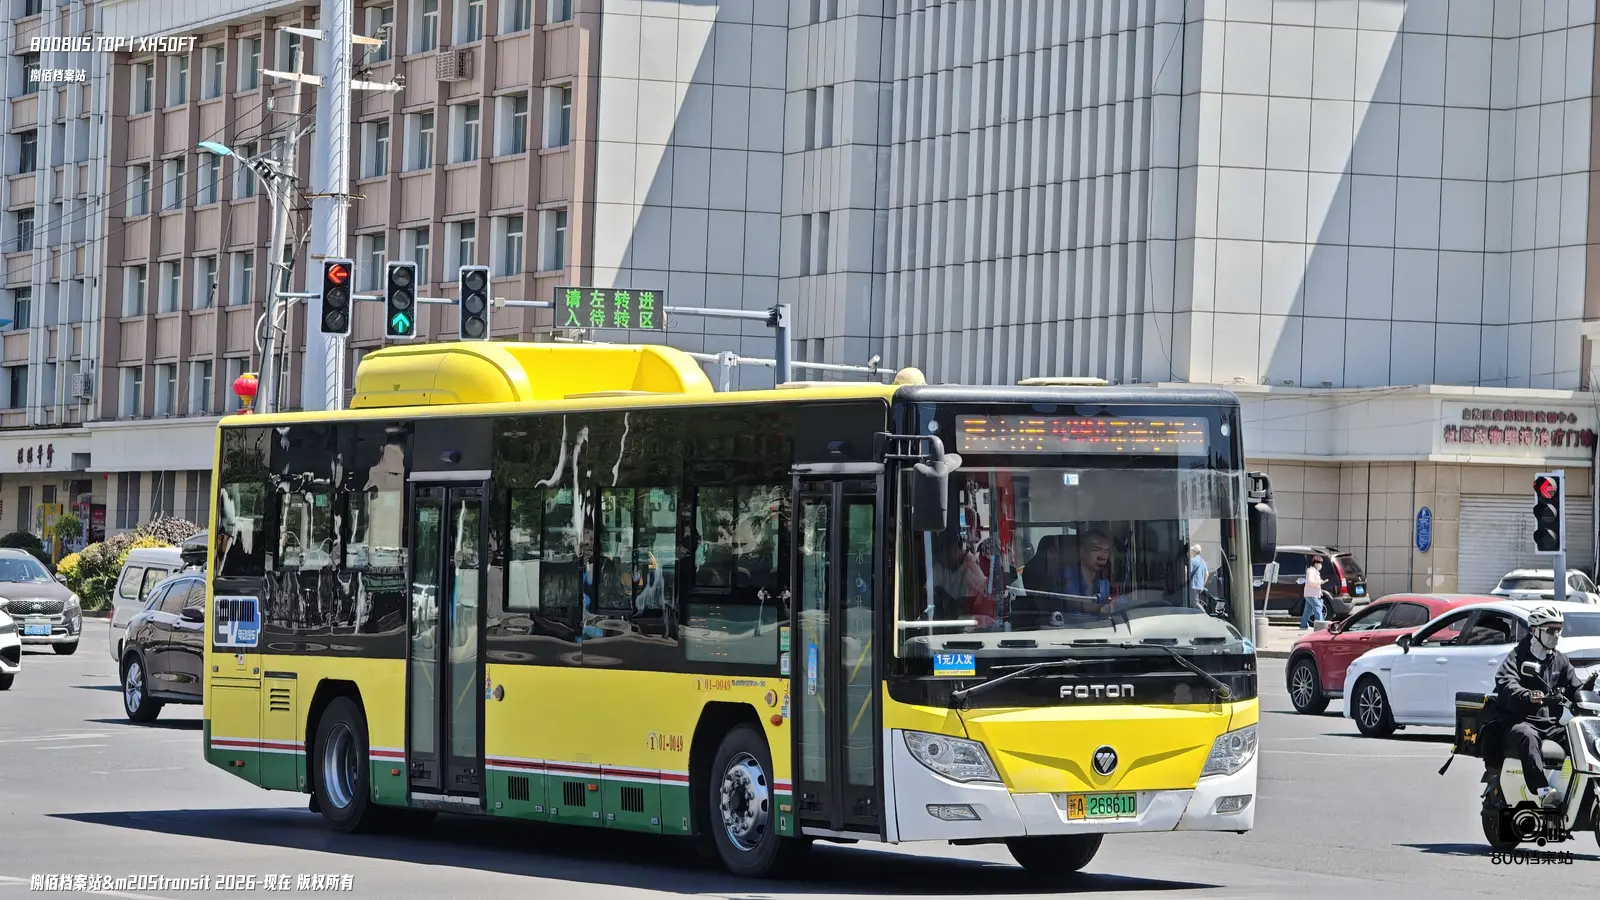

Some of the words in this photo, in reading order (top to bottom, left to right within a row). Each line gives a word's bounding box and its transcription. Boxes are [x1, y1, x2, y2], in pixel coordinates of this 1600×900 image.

[565, 289, 654, 310] 请左转进
[565, 309, 654, 329] 入待转区
[936, 653, 973, 665] 1元/人次
[704, 678, 731, 691] 01-0049
[1059, 683, 1135, 699] FOTON
[658, 733, 684, 752] 01-0049
[1090, 796, 1136, 815] 26861D
